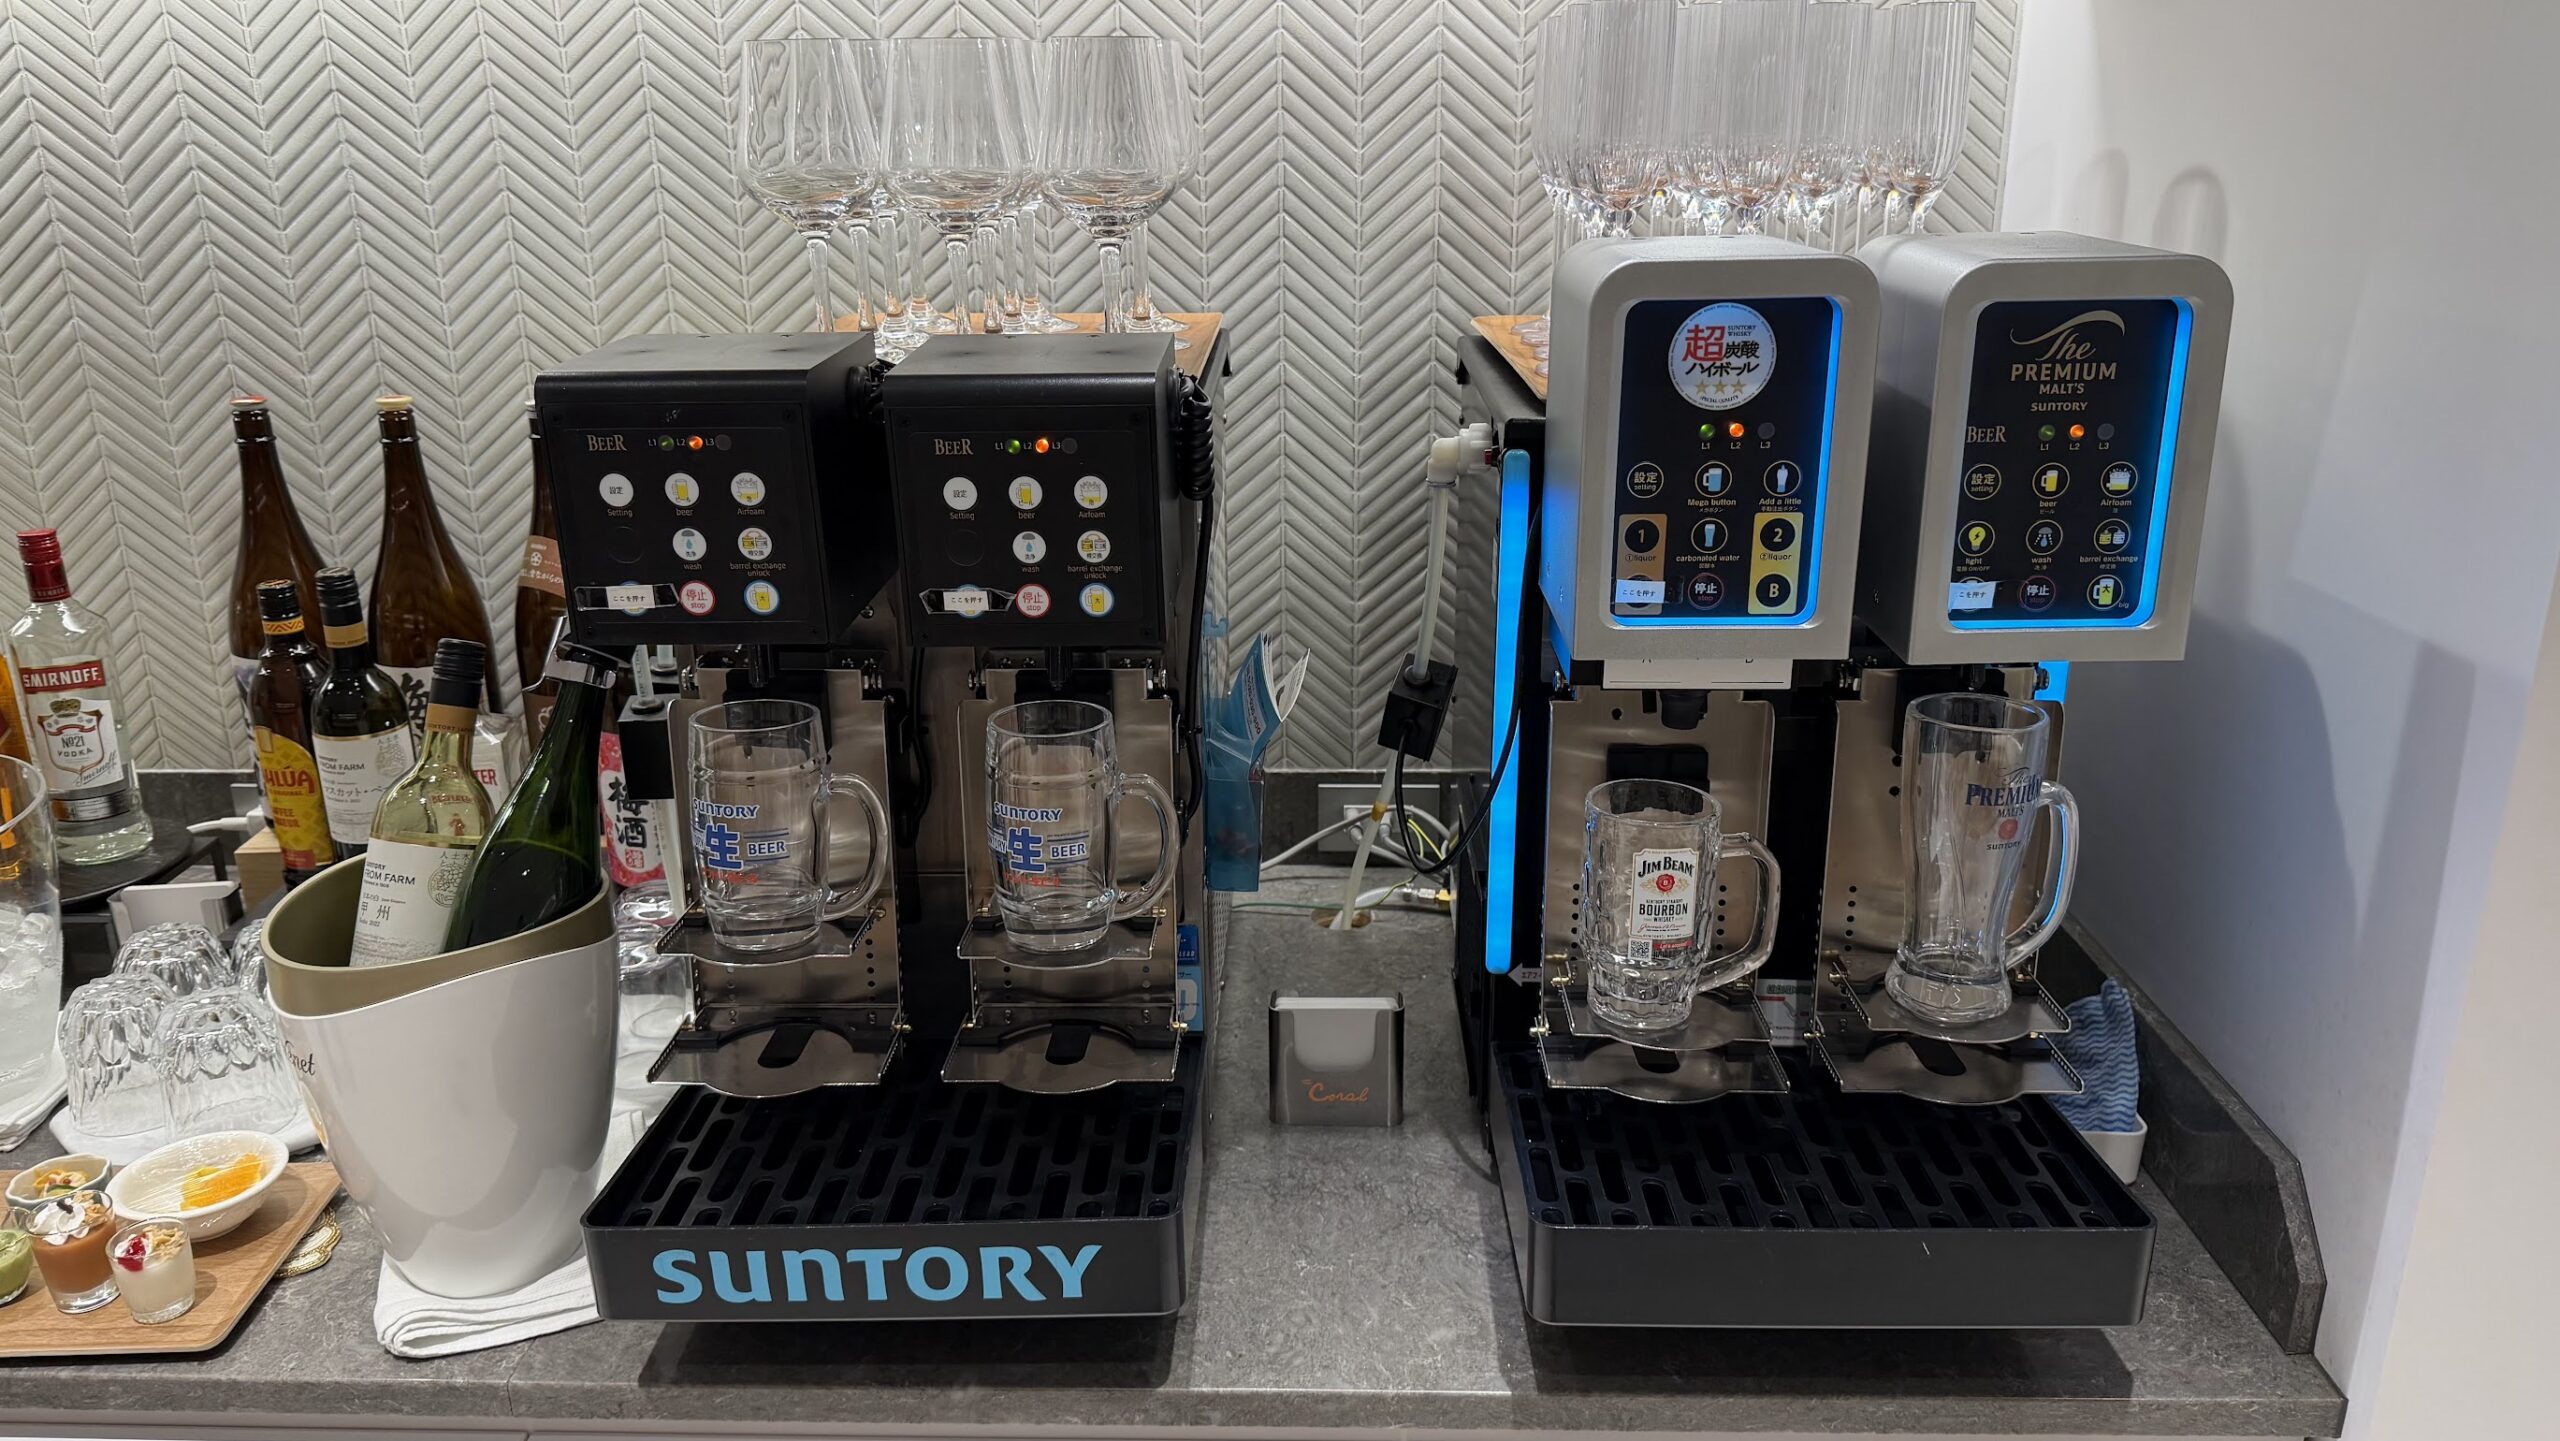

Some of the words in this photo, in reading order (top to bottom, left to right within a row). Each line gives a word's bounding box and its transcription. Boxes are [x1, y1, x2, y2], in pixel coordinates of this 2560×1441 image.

[2035, 327, 2096, 361] The
[1685, 361, 1760, 377] ハイボール
[2010, 362, 2117, 382] PREMIUM
[2039, 382, 2085, 395] MALT'S
[2030, 401, 2088, 411] SUNTORY
[1966, 425, 2007, 443] BEER
[587, 434, 627, 451] BEER
[648, 439, 657, 447] L1
[676, 439, 686, 447] L2
[706, 439, 715, 447] L3
[934, 438, 973, 455] BEER
[995, 442, 1004, 450] L1
[1023, 442, 1033, 450] L2
[1052, 442, 1061, 450] L3
[1701, 442, 1711, 450] L1
[1730, 441, 1742, 450] L2
[1760, 440, 1771, 449] L3
[2040, 443, 2049, 451] L1
[2069, 442, 2080, 451] L2
[2098, 442, 2109, 450] L3
[1634, 472, 1657, 483] 設定
[1971, 473, 1995, 485] 設定
[1634, 484, 1656, 492] setting
[1970, 484, 1994, 493] setting
[1688, 498, 1707, 507] Mega
[1711, 498, 1736, 506] button
[2039, 499, 2057, 508] beer
[2100, 498, 2132, 507] Airfoam
[607, 508, 633, 518] Setting
[676, 507, 693, 516] beer
[950, 511, 975, 520] Setting
[1018, 511, 1035, 519] beer
[1637, 528, 1645, 543] 1
[1773, 528, 1783, 543] 2
[1676, 554, 1717, 562] carbonated
[1719, 554, 1740, 562] water
[1965, 557, 1983, 566] light
[2031, 556, 2052, 564] wash
[2079, 555, 2101, 563] barrel
[2103, 555, 2139, 564] exchange
[684, 562, 702, 570] wash
[753, 562, 787, 571] exchange
[1022, 564, 1040, 573] wash
[1089, 565, 1123, 574] exchange
[1084, 572, 1106, 580] unlock
[1622, 589, 1656, 597] ここを押す
[1694, 583, 1717, 594] 停止
[1769, 584, 1780, 598] B
[2026, 585, 2050, 596] 停止
[2102, 583, 2111, 593] 大
[686, 589, 707, 602] 停止
[1022, 592, 1043, 604] 停止
[691, 602, 706, 611] stop
[1026, 604, 1041, 612] stop
[2118, 601, 2130, 609] big
[22, 667, 101, 687] SMIRNOFF
[57, 748, 94, 758] VODKA
[693, 798, 760, 818] SUNTORY
[994, 801, 1063, 822] SUNTORY
[747, 840, 786, 857] BEER
[1050, 842, 1087, 859] BEER
[1637, 860, 1662, 878] JIM
[1663, 856, 1694, 878] BEAM
[384, 873, 416, 885] FARM
[1639, 903, 1688, 916] BOURBON
[1308, 1082, 1370, 1104] Coral
[652, 1244, 1103, 1304] SUNTORY
